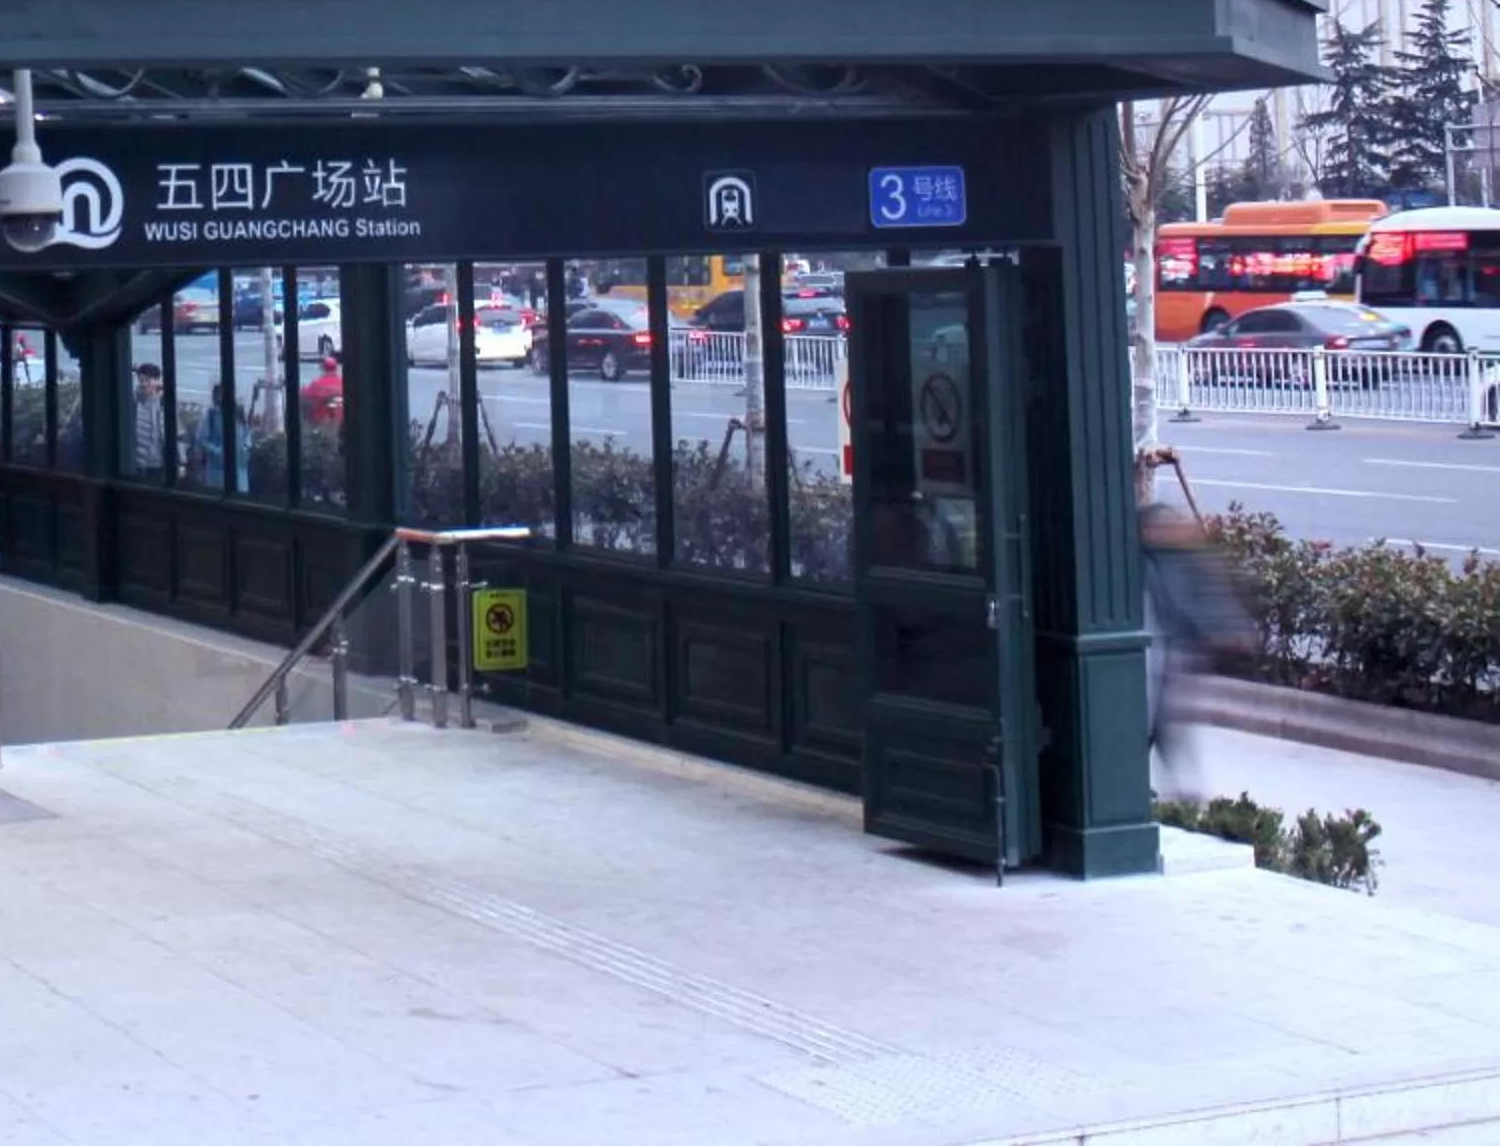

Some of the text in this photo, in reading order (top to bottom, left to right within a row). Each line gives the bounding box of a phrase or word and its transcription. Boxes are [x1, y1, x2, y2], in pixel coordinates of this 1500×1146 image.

[156, 159, 407, 210] 五四广场站
[145, 218, 421, 241] WUSI GUANGCHANG Station
